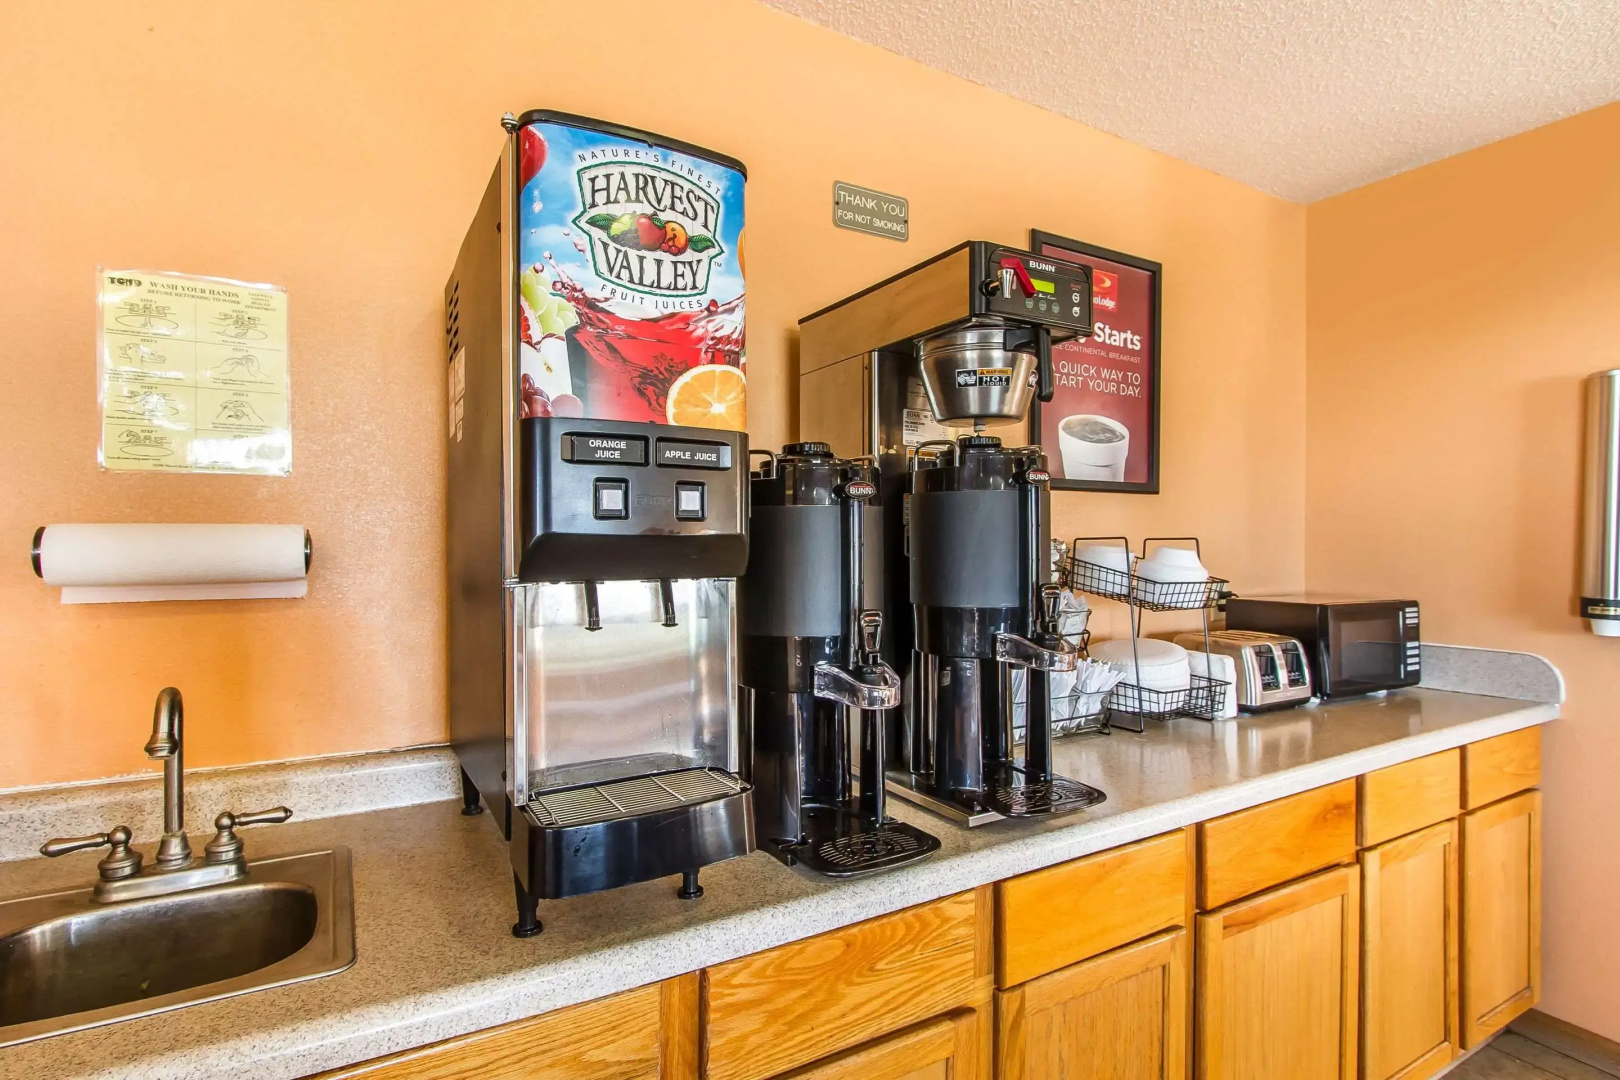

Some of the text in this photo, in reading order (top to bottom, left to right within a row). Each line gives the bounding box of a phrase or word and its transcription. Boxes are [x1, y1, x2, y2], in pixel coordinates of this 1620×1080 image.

[578, 149, 722, 195] NATURE'S FINEST
[588, 171, 715, 233] HARVEST
[838, 191, 905, 217] THANK YOU
[838, 209, 905, 233] FOR NOT SMOKING
[598, 237, 703, 291] VALLEY
[1029, 260, 1055, 272] BUNN
[150, 281, 239, 298] WASH YOUR HANDS
[175, 292, 211, 301] RETURNING
[601, 284, 703, 309] FRUIT JUICES
[1094, 322, 1141, 350] Starts
[1065, 344, 1108, 358] CONTINENTAL
[1059, 361, 1097, 377] QUICK
[1100, 367, 1124, 382] WAY
[1127, 372, 1141, 385] TO
[1054, 373, 1142, 398] TART YOUR DAY.
[589, 439, 627, 449] ORANGE
[595, 450, 621, 459] JUICE
[664, 450, 717, 461] APPLE JUICE
[849, 487, 872, 495] BUNN
